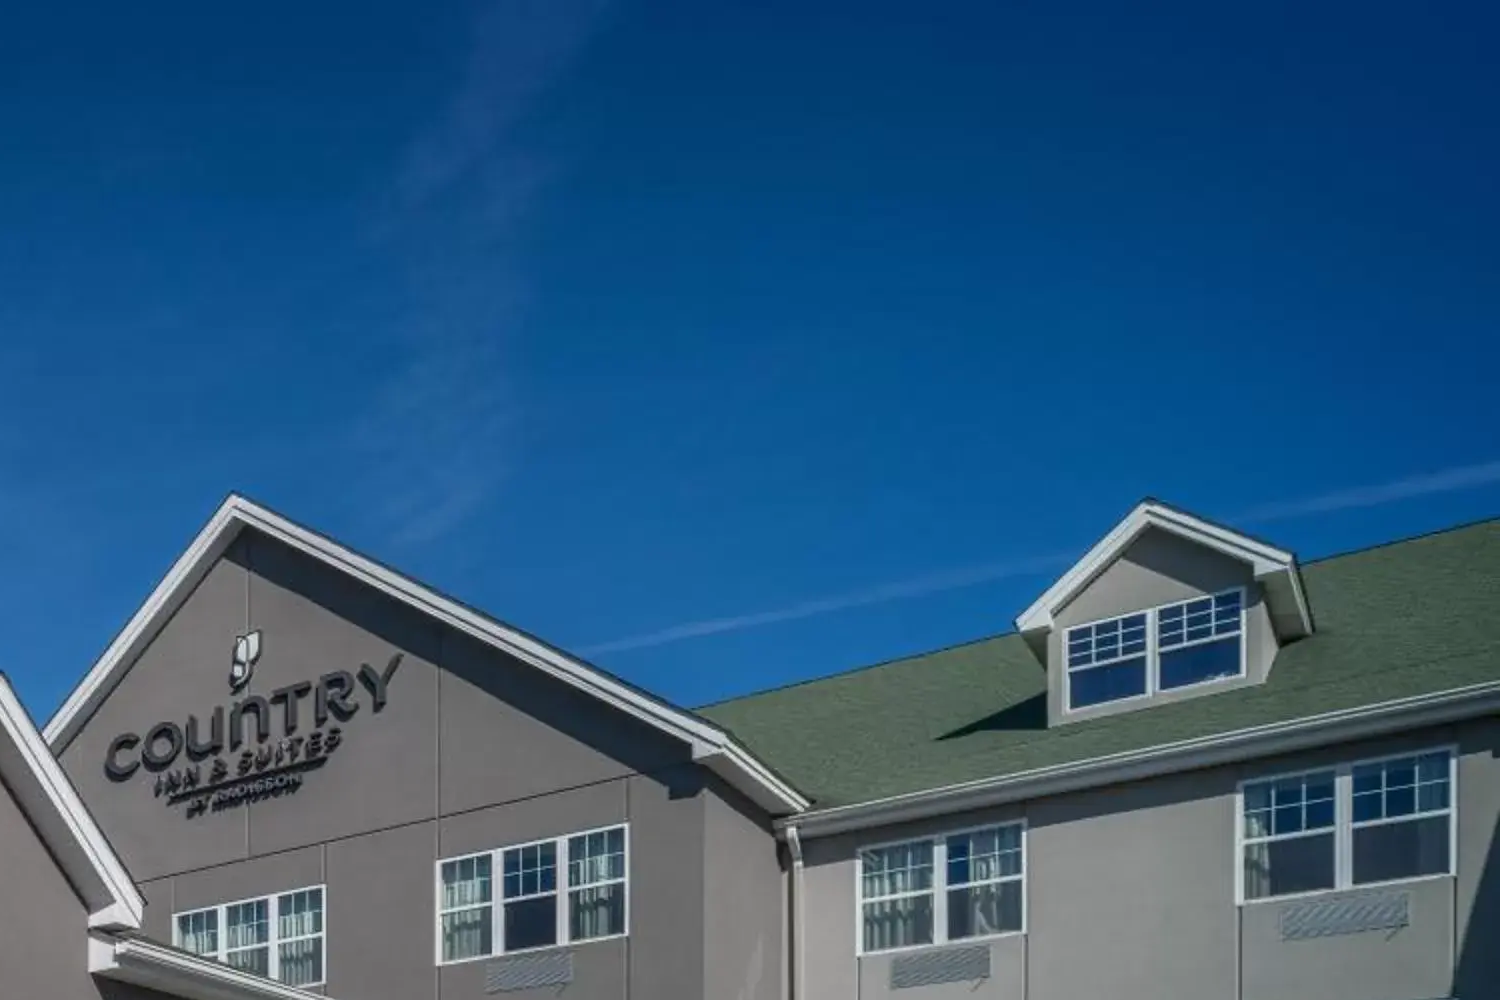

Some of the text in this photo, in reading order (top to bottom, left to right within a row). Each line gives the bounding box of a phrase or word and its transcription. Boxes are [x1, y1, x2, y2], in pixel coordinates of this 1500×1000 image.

[104, 653, 403, 782] COUNTRY
[154, 765, 200, 798] INN
[237, 727, 343, 774] SUITES
